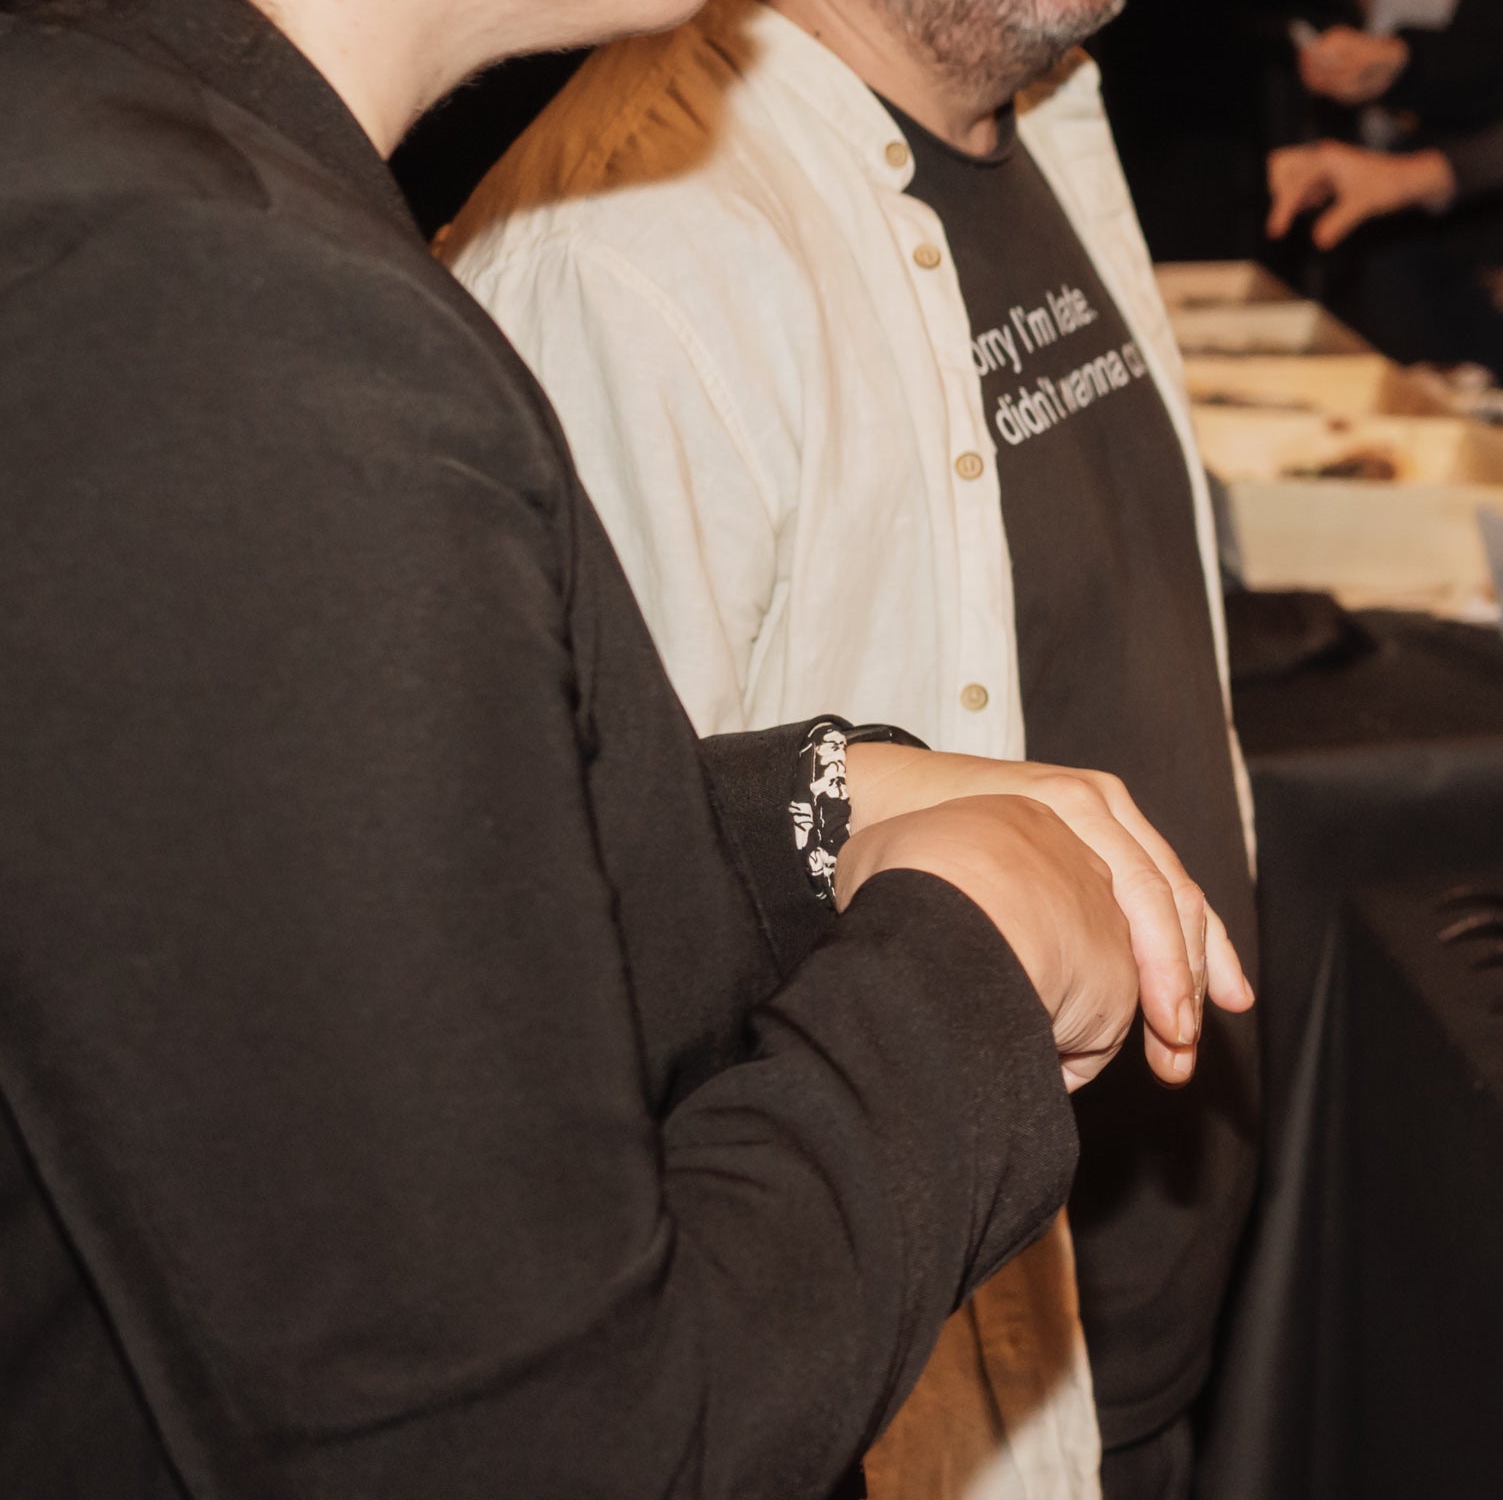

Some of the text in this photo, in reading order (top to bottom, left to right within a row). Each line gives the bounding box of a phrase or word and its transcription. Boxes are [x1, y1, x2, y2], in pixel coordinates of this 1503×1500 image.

[971, 325, 1022, 377] orry
[1009, 304, 1057, 354] I'm
[995, 376, 1067, 445] didn't
[1058, 350, 1130, 414] wanna
